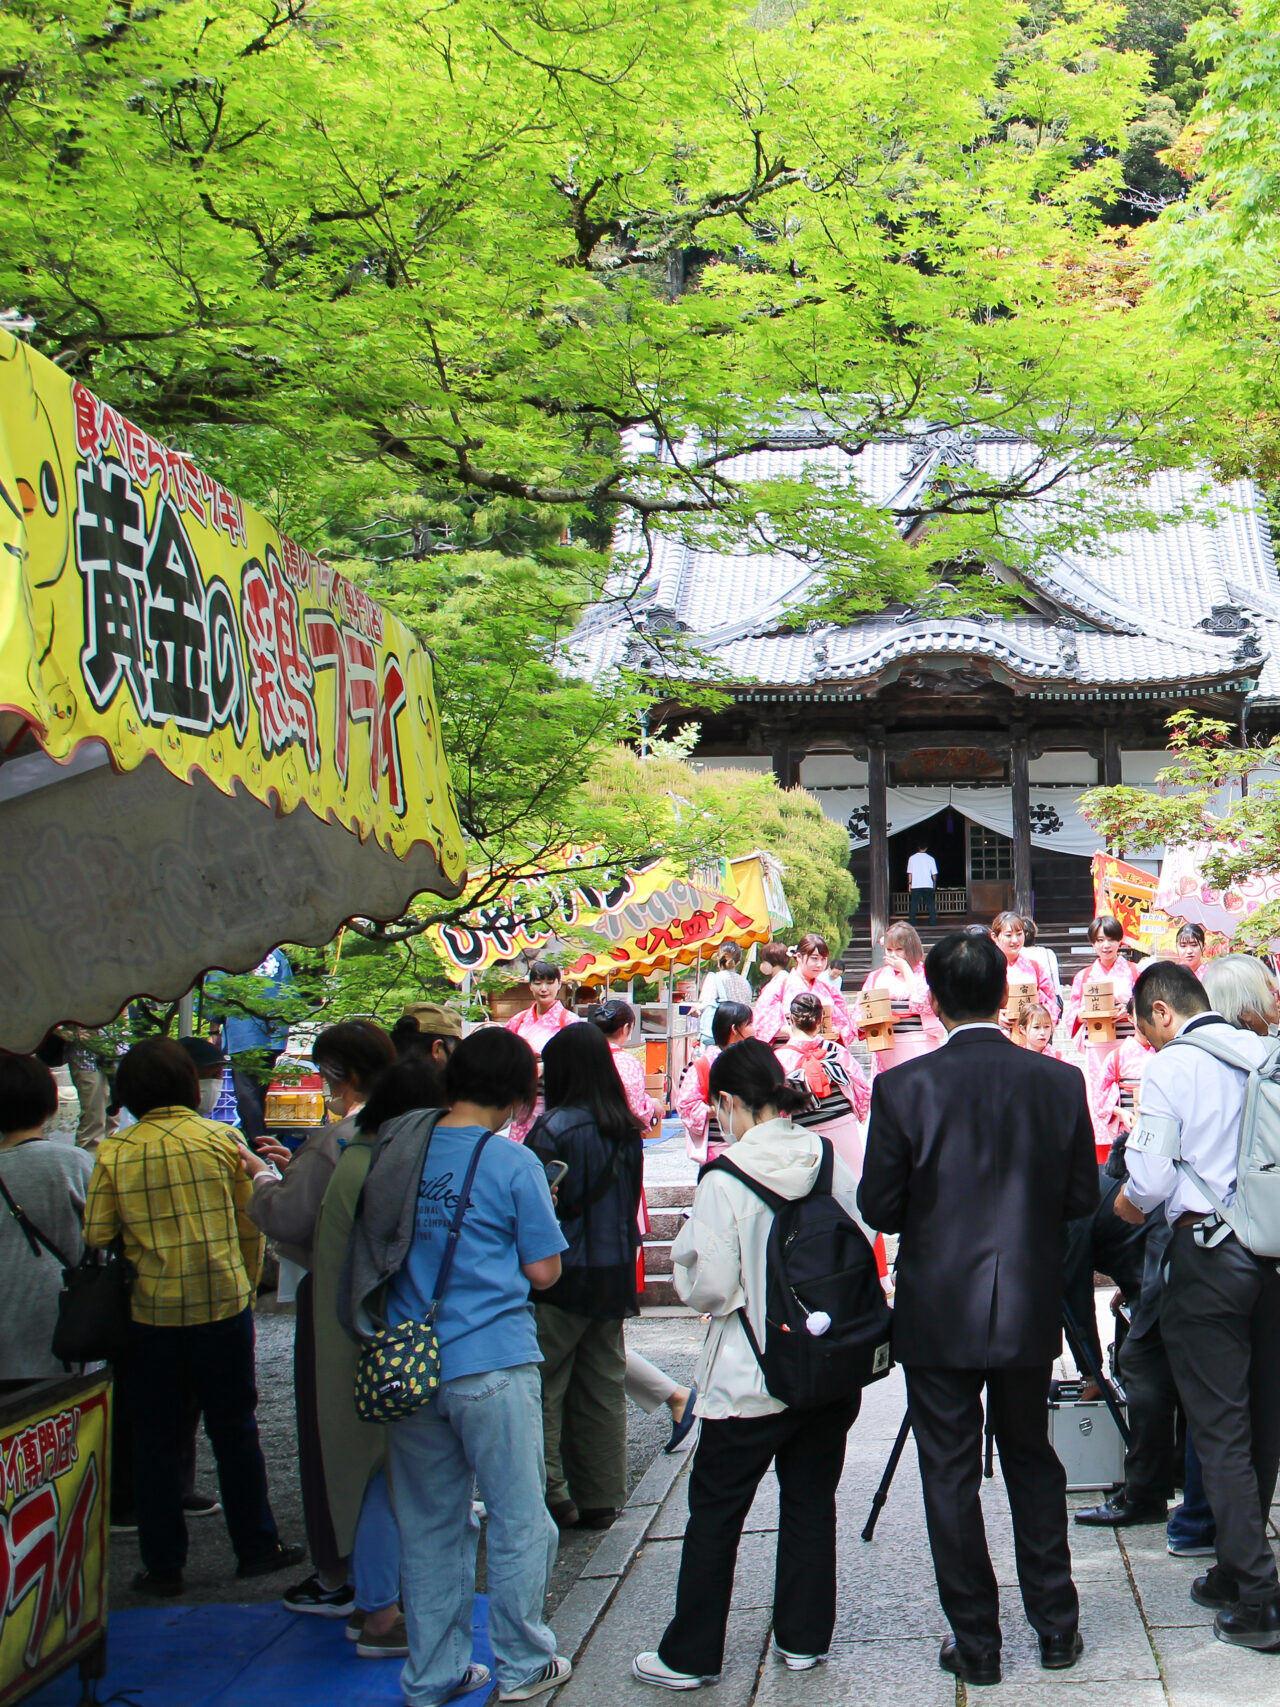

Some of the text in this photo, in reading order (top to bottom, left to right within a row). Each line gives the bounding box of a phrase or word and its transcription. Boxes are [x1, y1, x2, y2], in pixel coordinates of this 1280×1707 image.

[76, 458, 407, 818] 黄金の鶏フライ
[0, 1406, 81, 1503] イ専門店!
[0, 1452, 99, 1673] ライ
